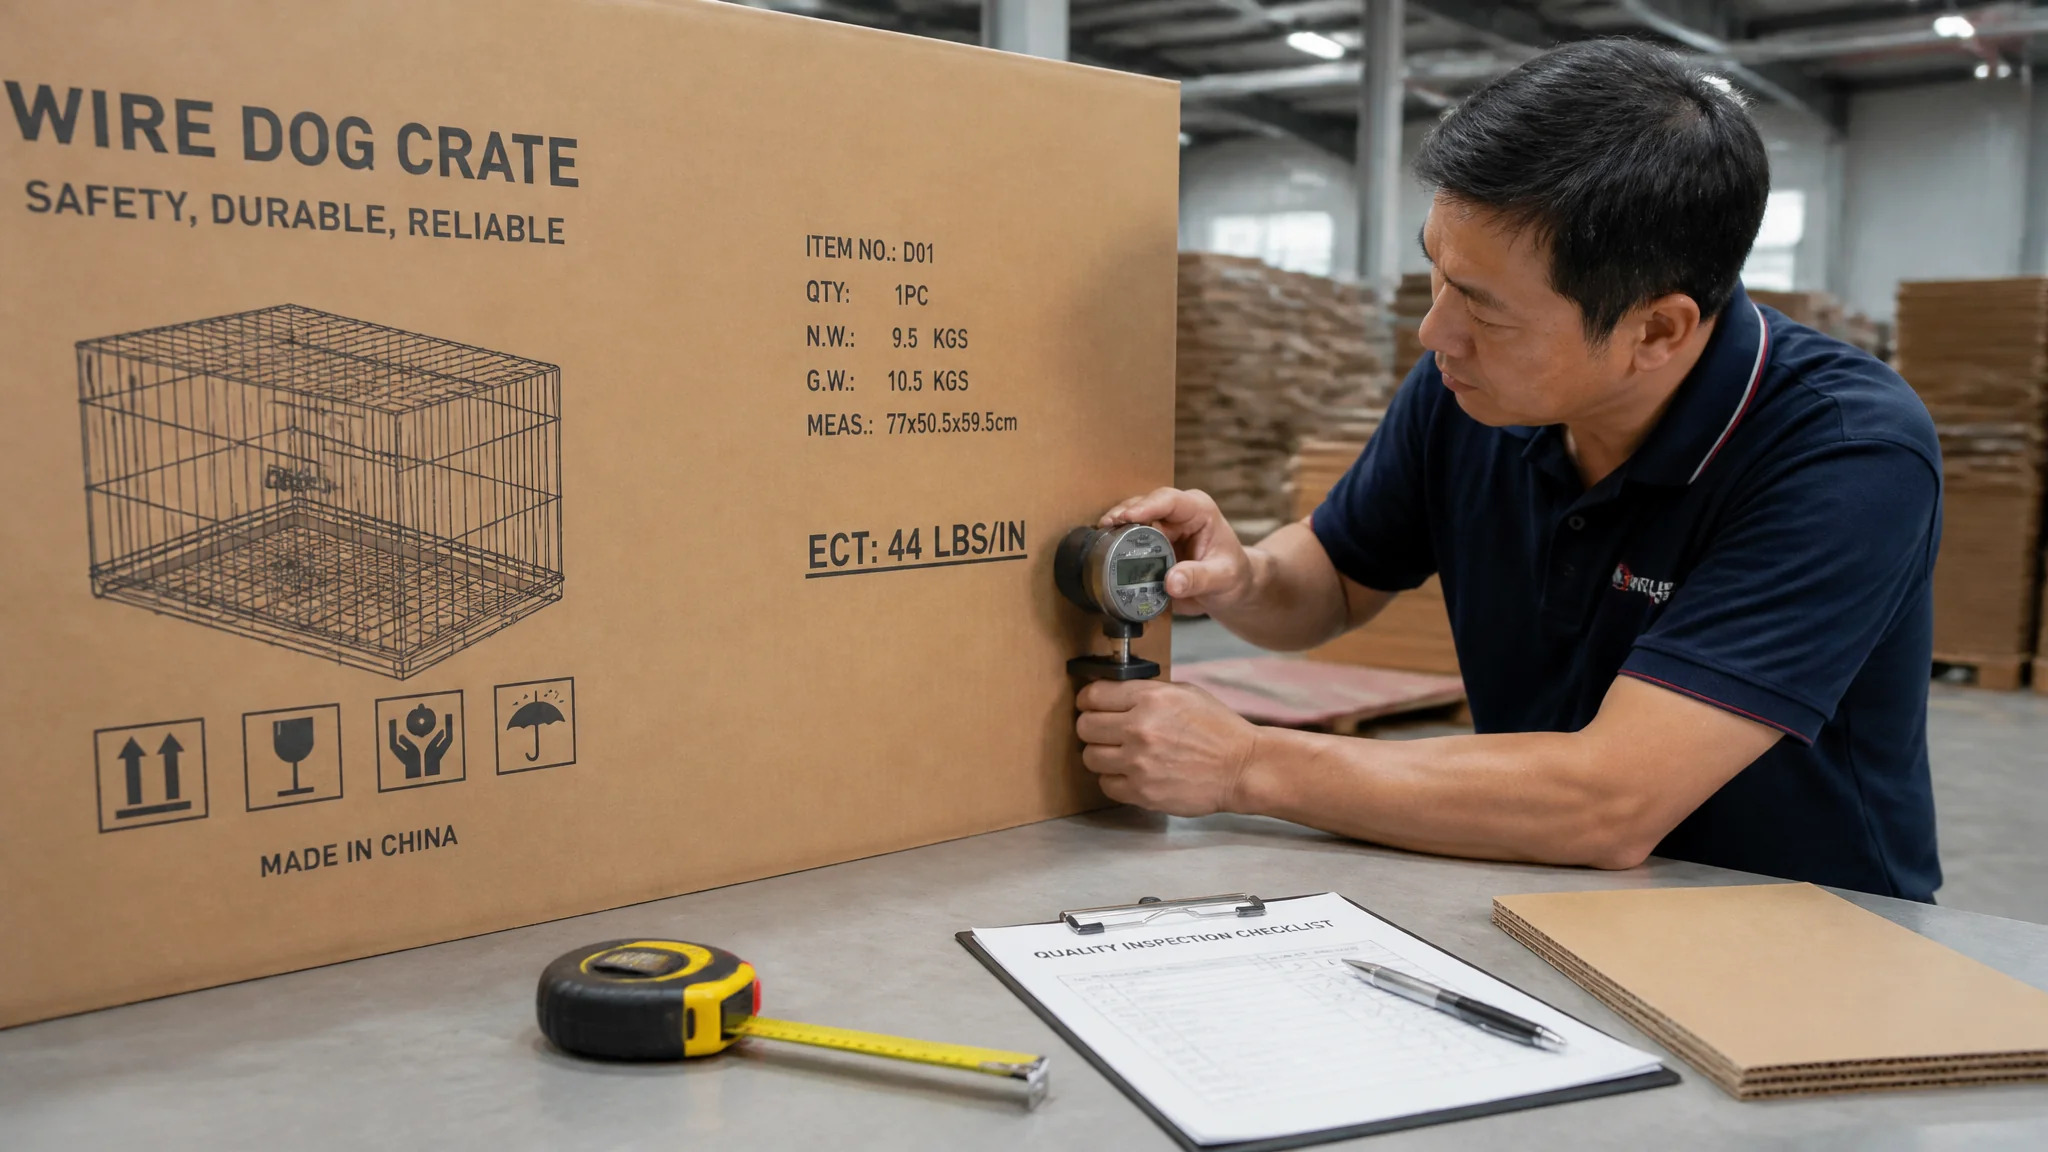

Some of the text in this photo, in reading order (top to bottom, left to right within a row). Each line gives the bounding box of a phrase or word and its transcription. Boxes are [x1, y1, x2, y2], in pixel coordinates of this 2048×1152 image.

[4, 80, 579, 188] WIRE DOG CRATE
[25, 180, 565, 245] SAFETY, DURABLE, RELIABLE
[806, 234, 933, 264] ITEM NO.: D01
[806, 279, 929, 306] QTY: 1PC
[807, 324, 968, 349] N.W.: 9.5 KGS
[807, 369, 969, 392] G.W.: 10.5 KGS
[807, 411, 1018, 436] MEAS.: 77x50.5x59.5cm
[809, 520, 1026, 569] ECT: 44 LBS/IN
[260, 824, 459, 878] MADE IN CHINA
[1034, 919, 1334, 959] QUALITY INSPECTION CHECKLIST
